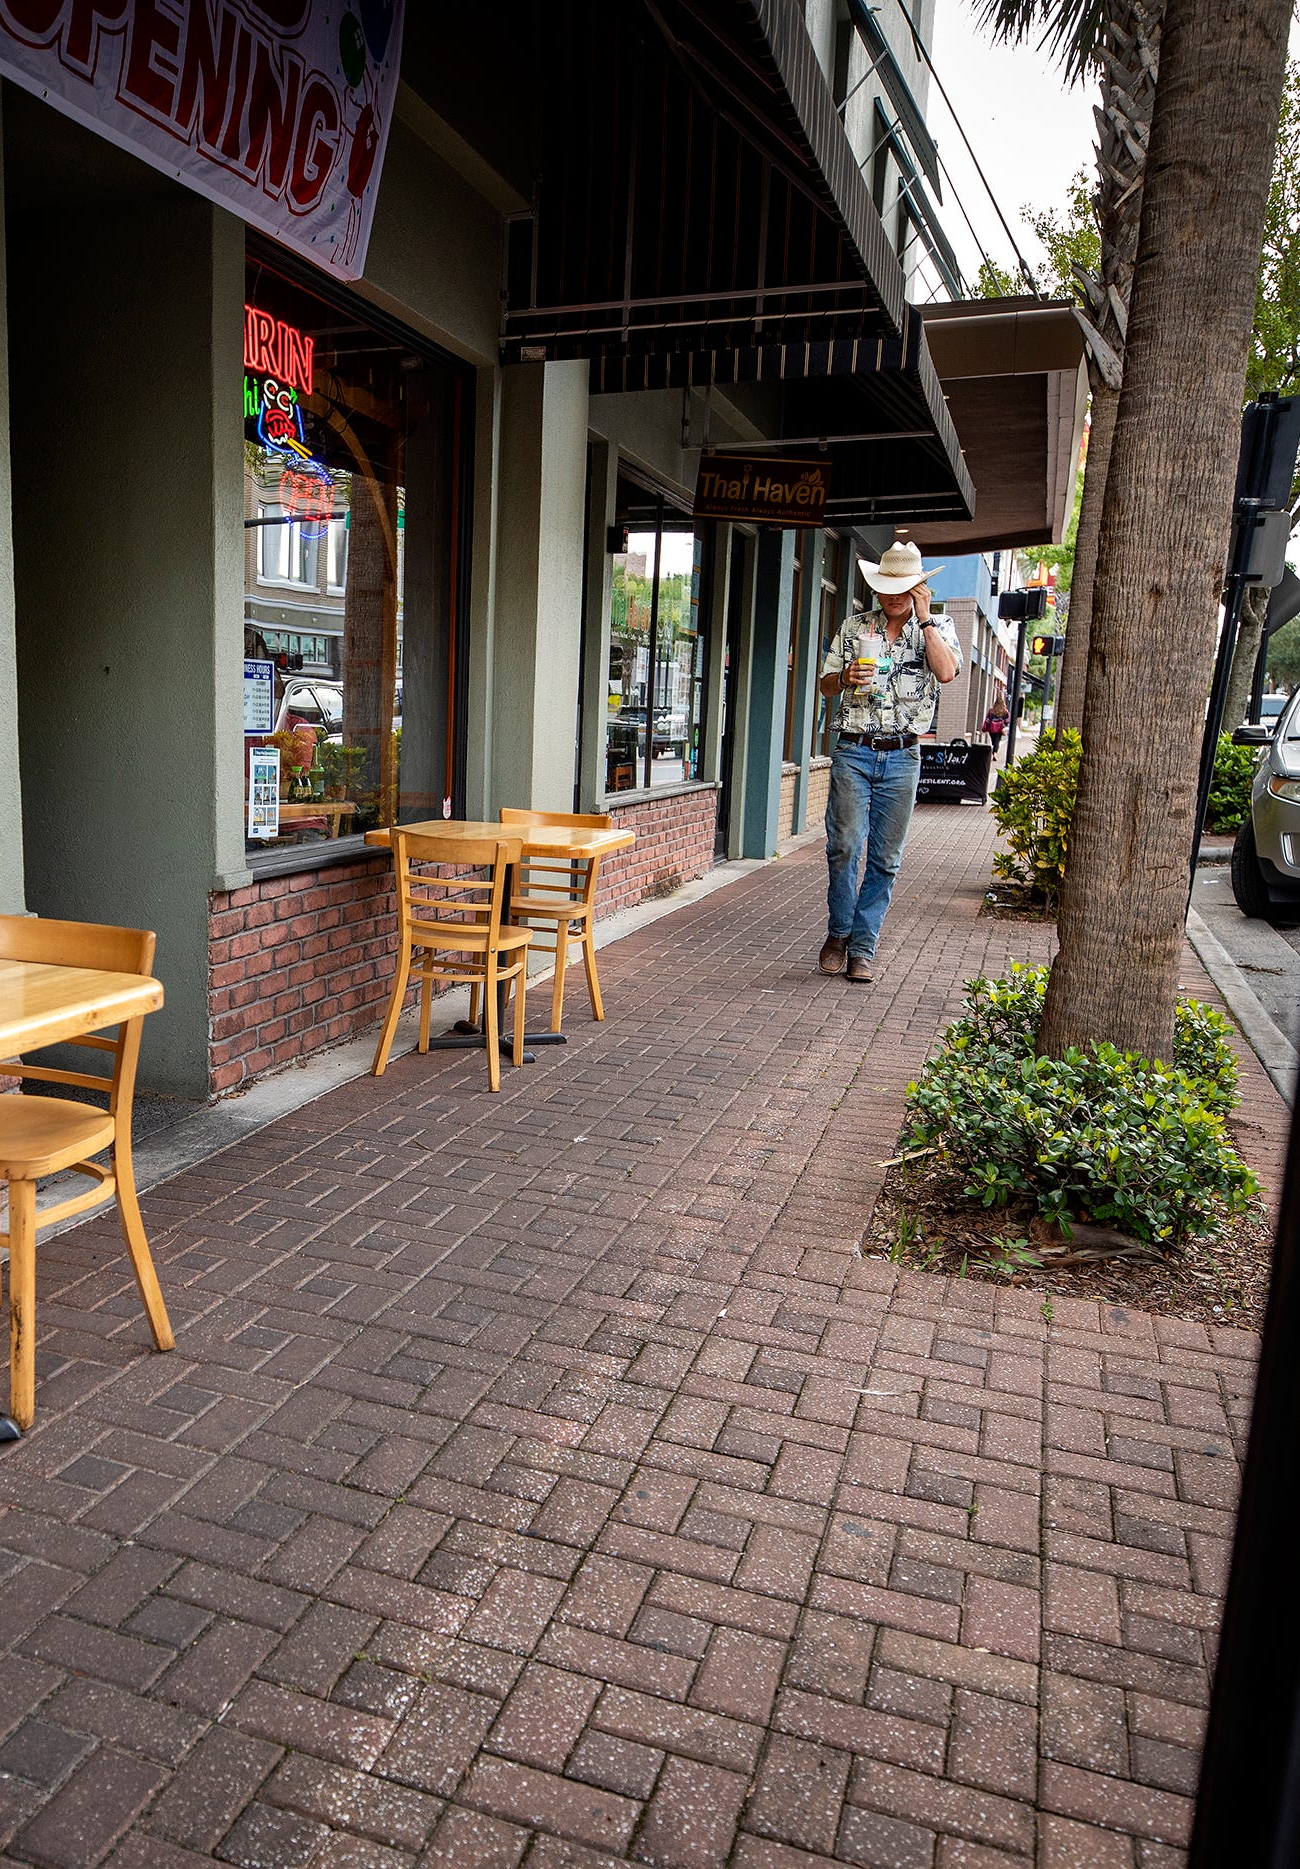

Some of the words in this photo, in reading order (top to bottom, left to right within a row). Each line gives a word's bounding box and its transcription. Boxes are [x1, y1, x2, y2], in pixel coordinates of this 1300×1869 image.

[244, 305, 314, 396] IRIN
[700, 467, 749, 500] Thai
[753, 473, 826, 506] Haven
